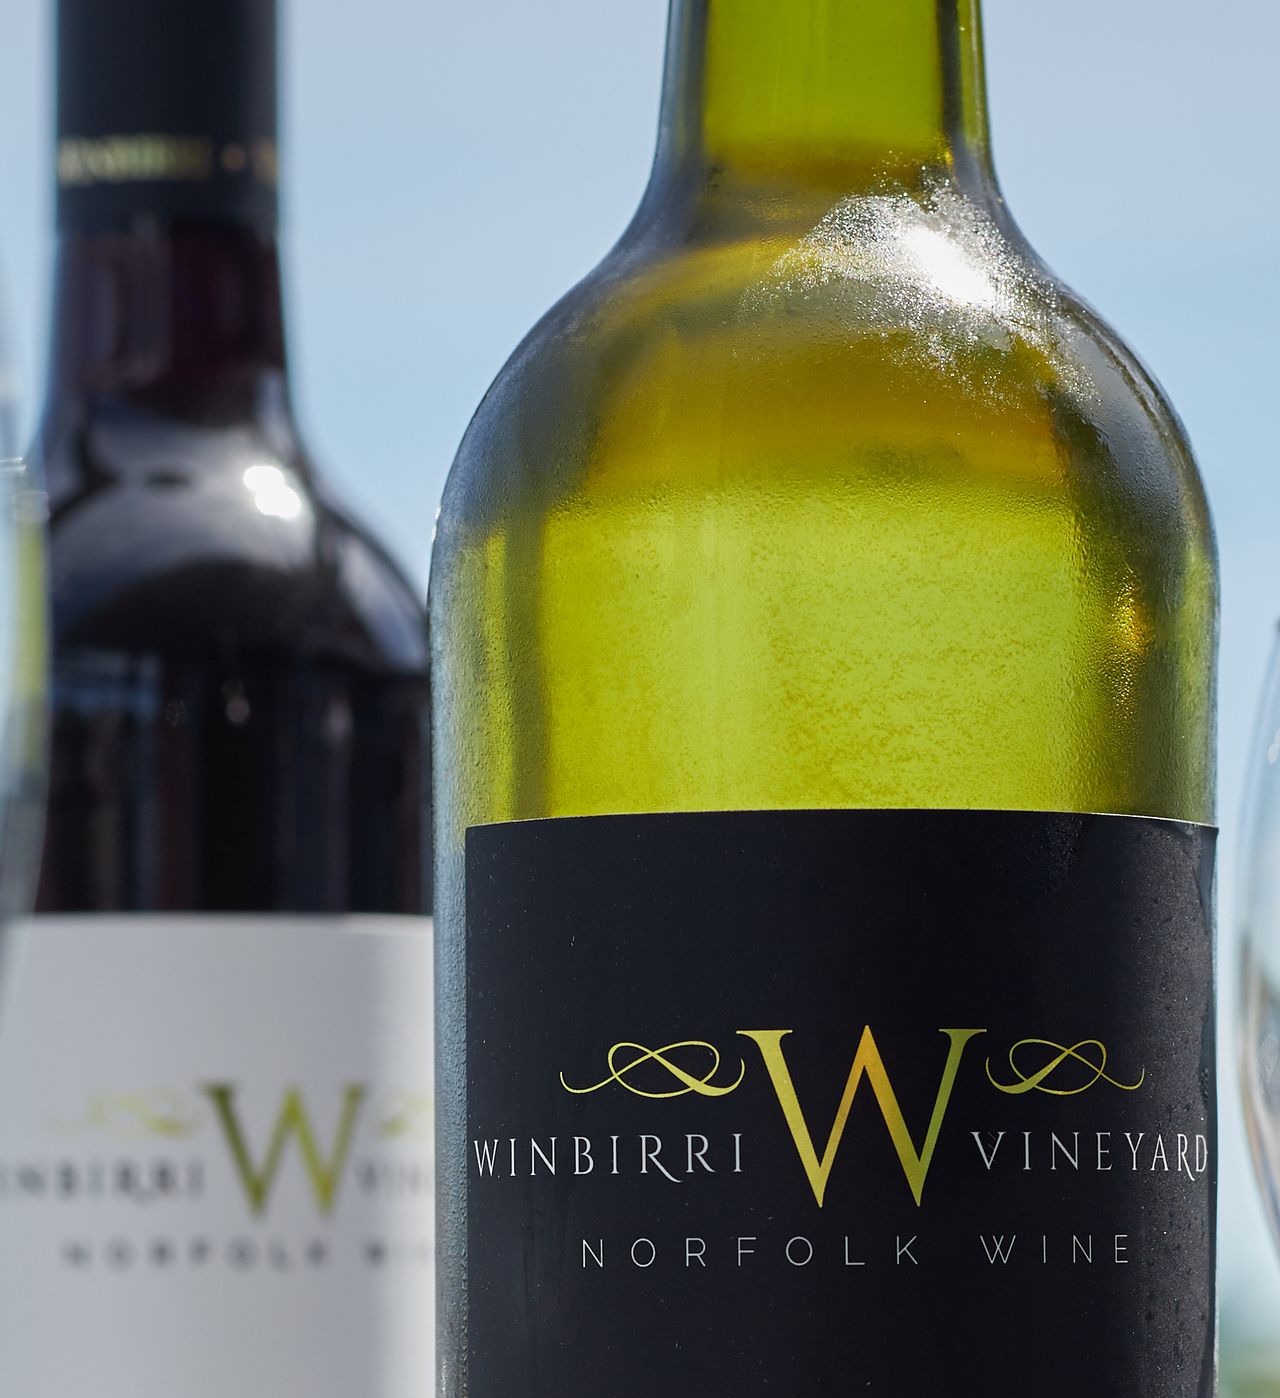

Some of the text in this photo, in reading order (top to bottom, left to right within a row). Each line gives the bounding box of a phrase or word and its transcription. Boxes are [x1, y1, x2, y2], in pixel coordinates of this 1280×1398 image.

[200, 1081, 366, 1220] W
[473, 1132, 744, 1184] WINBIRRI
[970, 1130, 1209, 1182] VINEYARD
[736, 1024, 988, 1208] W
[581, 1233, 1130, 1268] NORFOLK WINE
